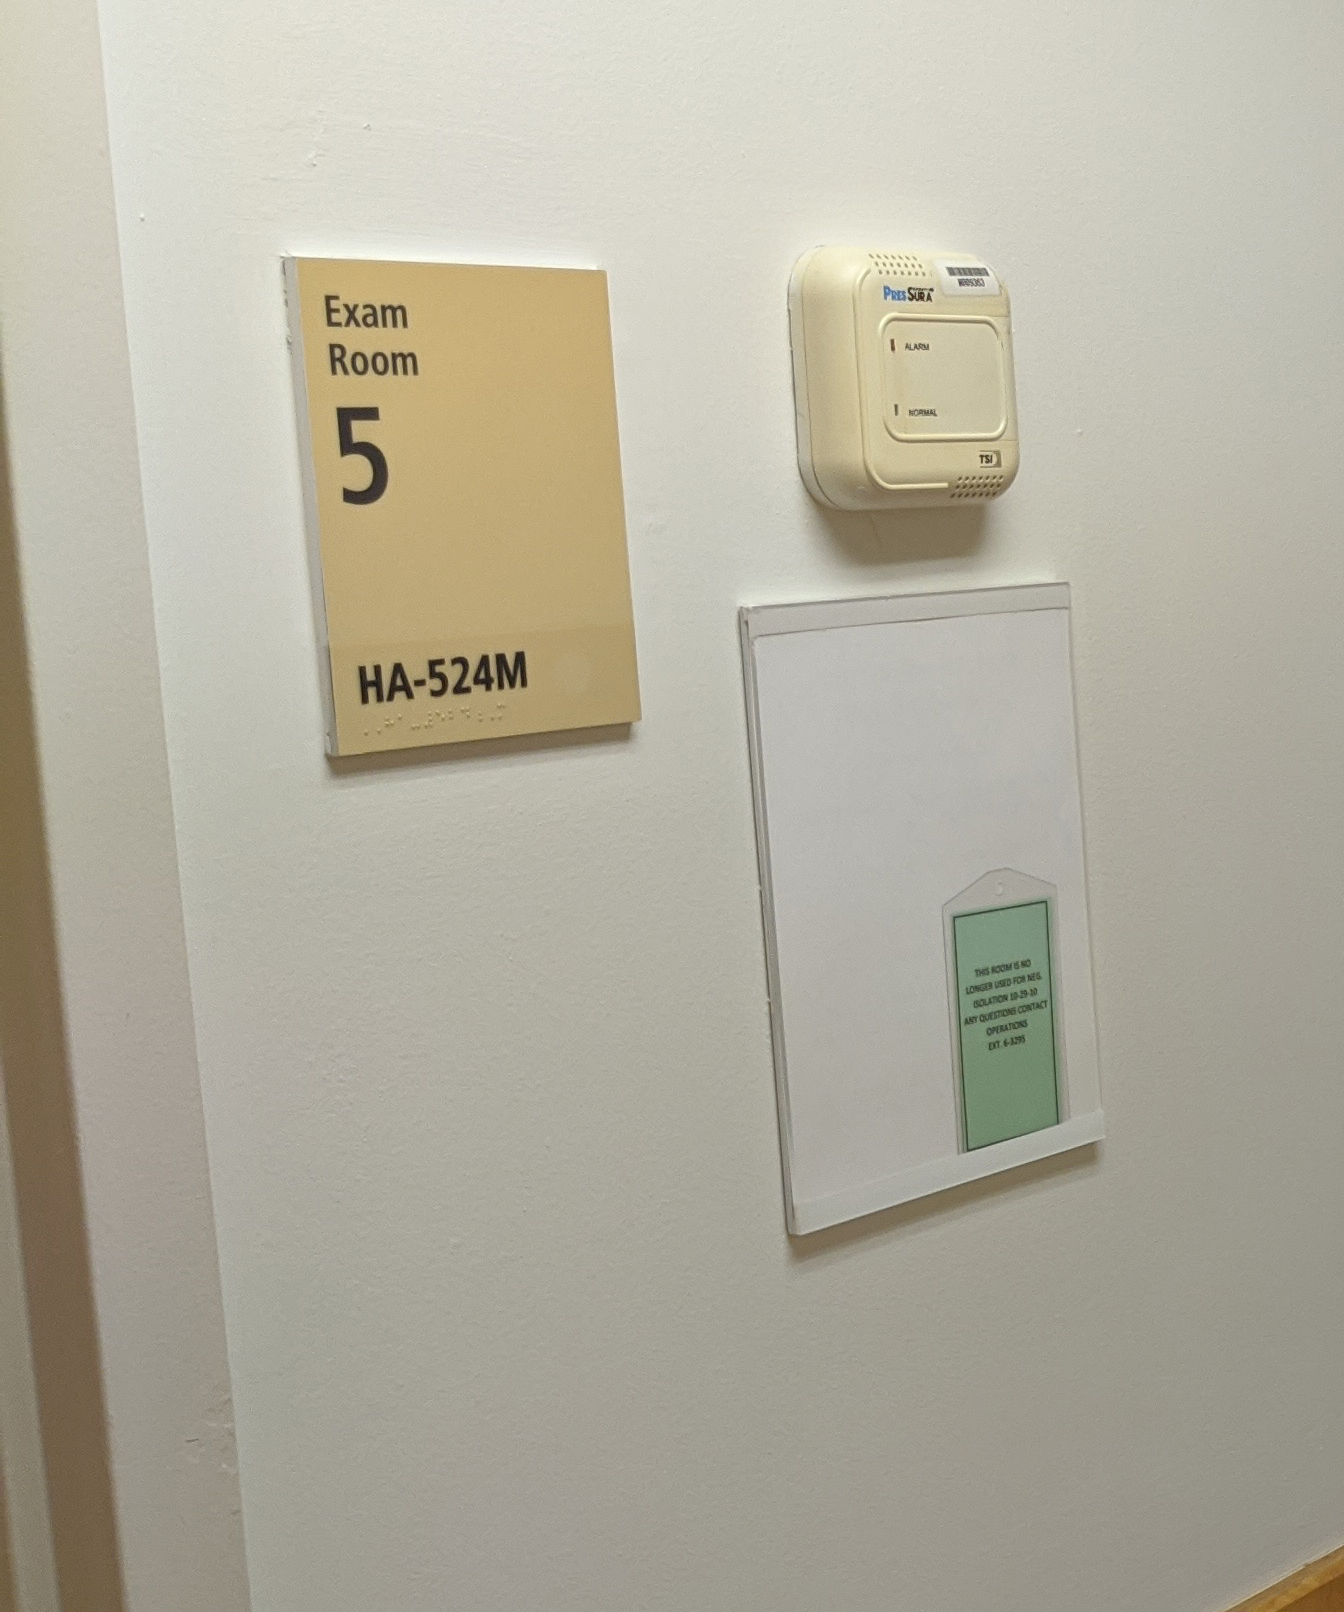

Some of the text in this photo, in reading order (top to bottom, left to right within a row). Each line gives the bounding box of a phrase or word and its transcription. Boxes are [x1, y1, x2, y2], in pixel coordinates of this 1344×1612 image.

[324, 294, 408, 329] Exam
[904, 343, 929, 351] ALARM
[328, 342, 419, 376] Room
[908, 409, 938, 417] NORMAL
[336, 406, 389, 505] 5
[979, 454, 993, 464] TSI
[358, 651, 528, 705] HA-524M
[975, 967, 990, 977] THIS
[991, 963, 1012, 975] ROOM
[1013, 961, 1020, 970] IS
[966, 981, 993, 995] LONGER
[994, 977, 1011, 989] USED
[1012, 974, 1026, 985] FOR
[973, 994, 1008, 1009] ISOLATION
[964, 1000, 1048, 1026] ANY QUESTIONS CONTACT
[986, 1019, 1028, 1036] OPERATIONS
